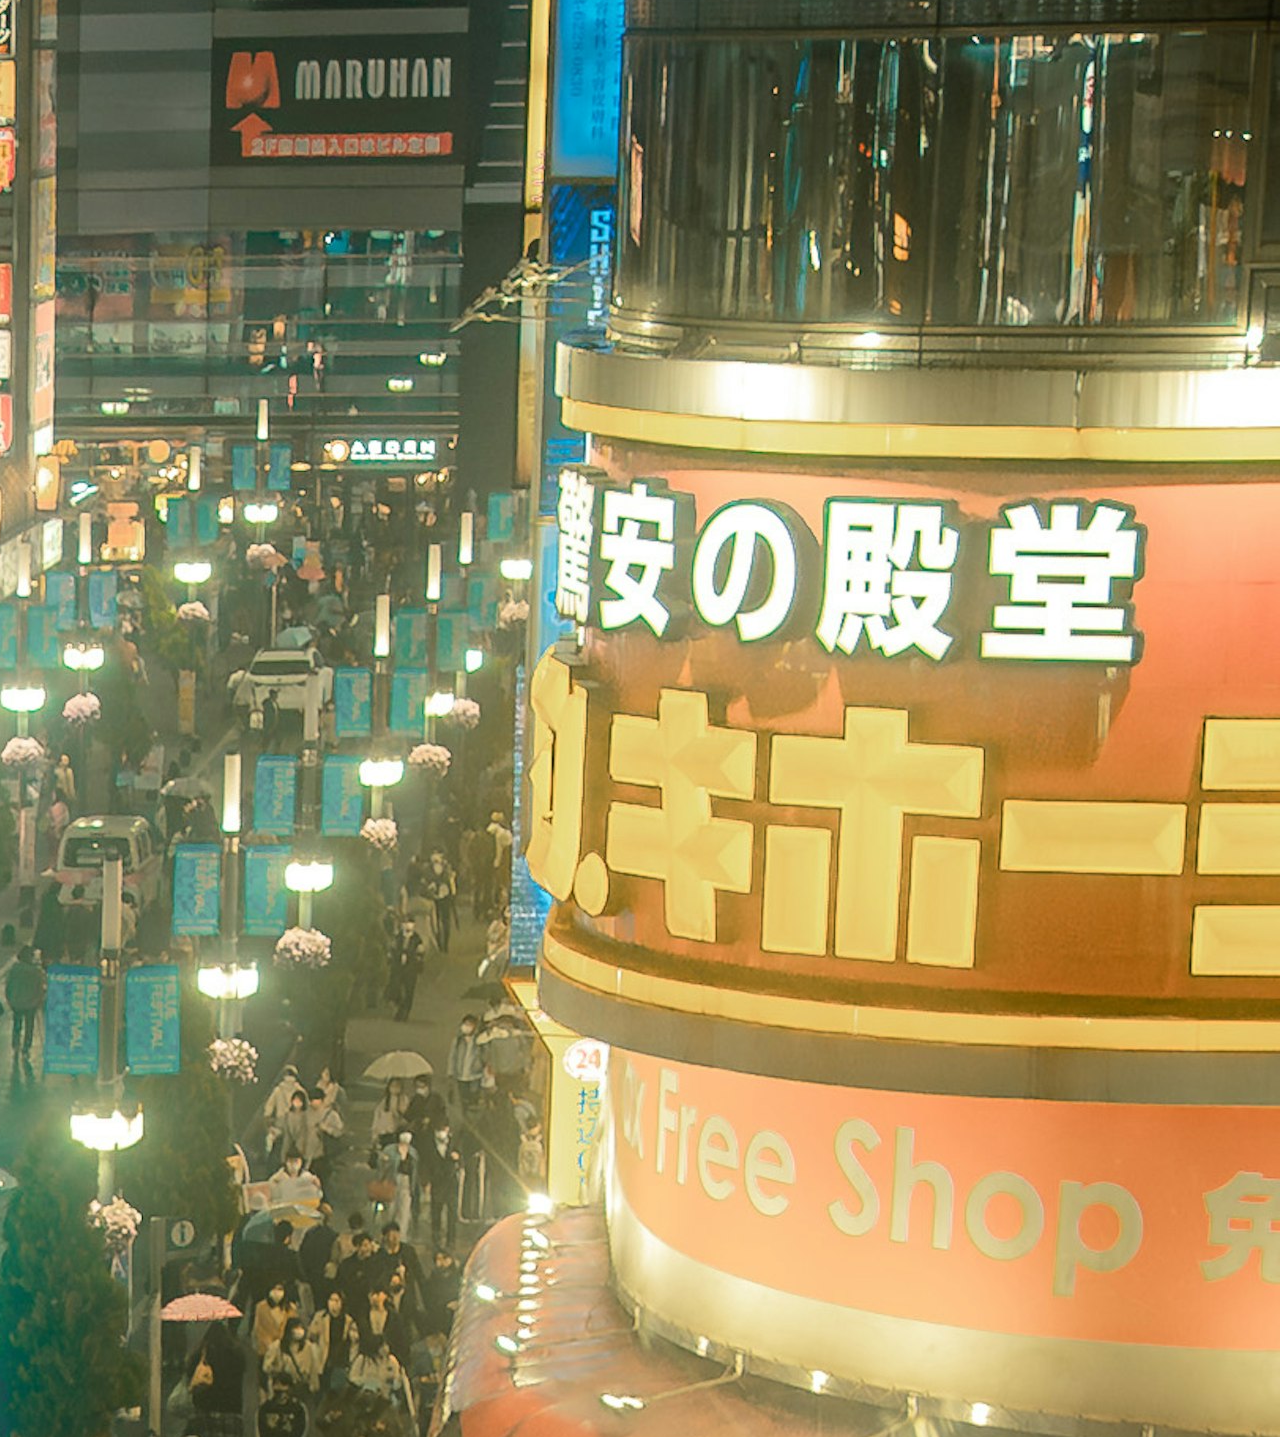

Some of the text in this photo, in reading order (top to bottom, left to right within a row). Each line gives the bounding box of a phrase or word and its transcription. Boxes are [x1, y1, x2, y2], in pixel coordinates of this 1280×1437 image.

[295, 57, 452, 100] MARUHAN
[656, 1068, 797, 1218] Free
[827, 1118, 1145, 1299] Shop
